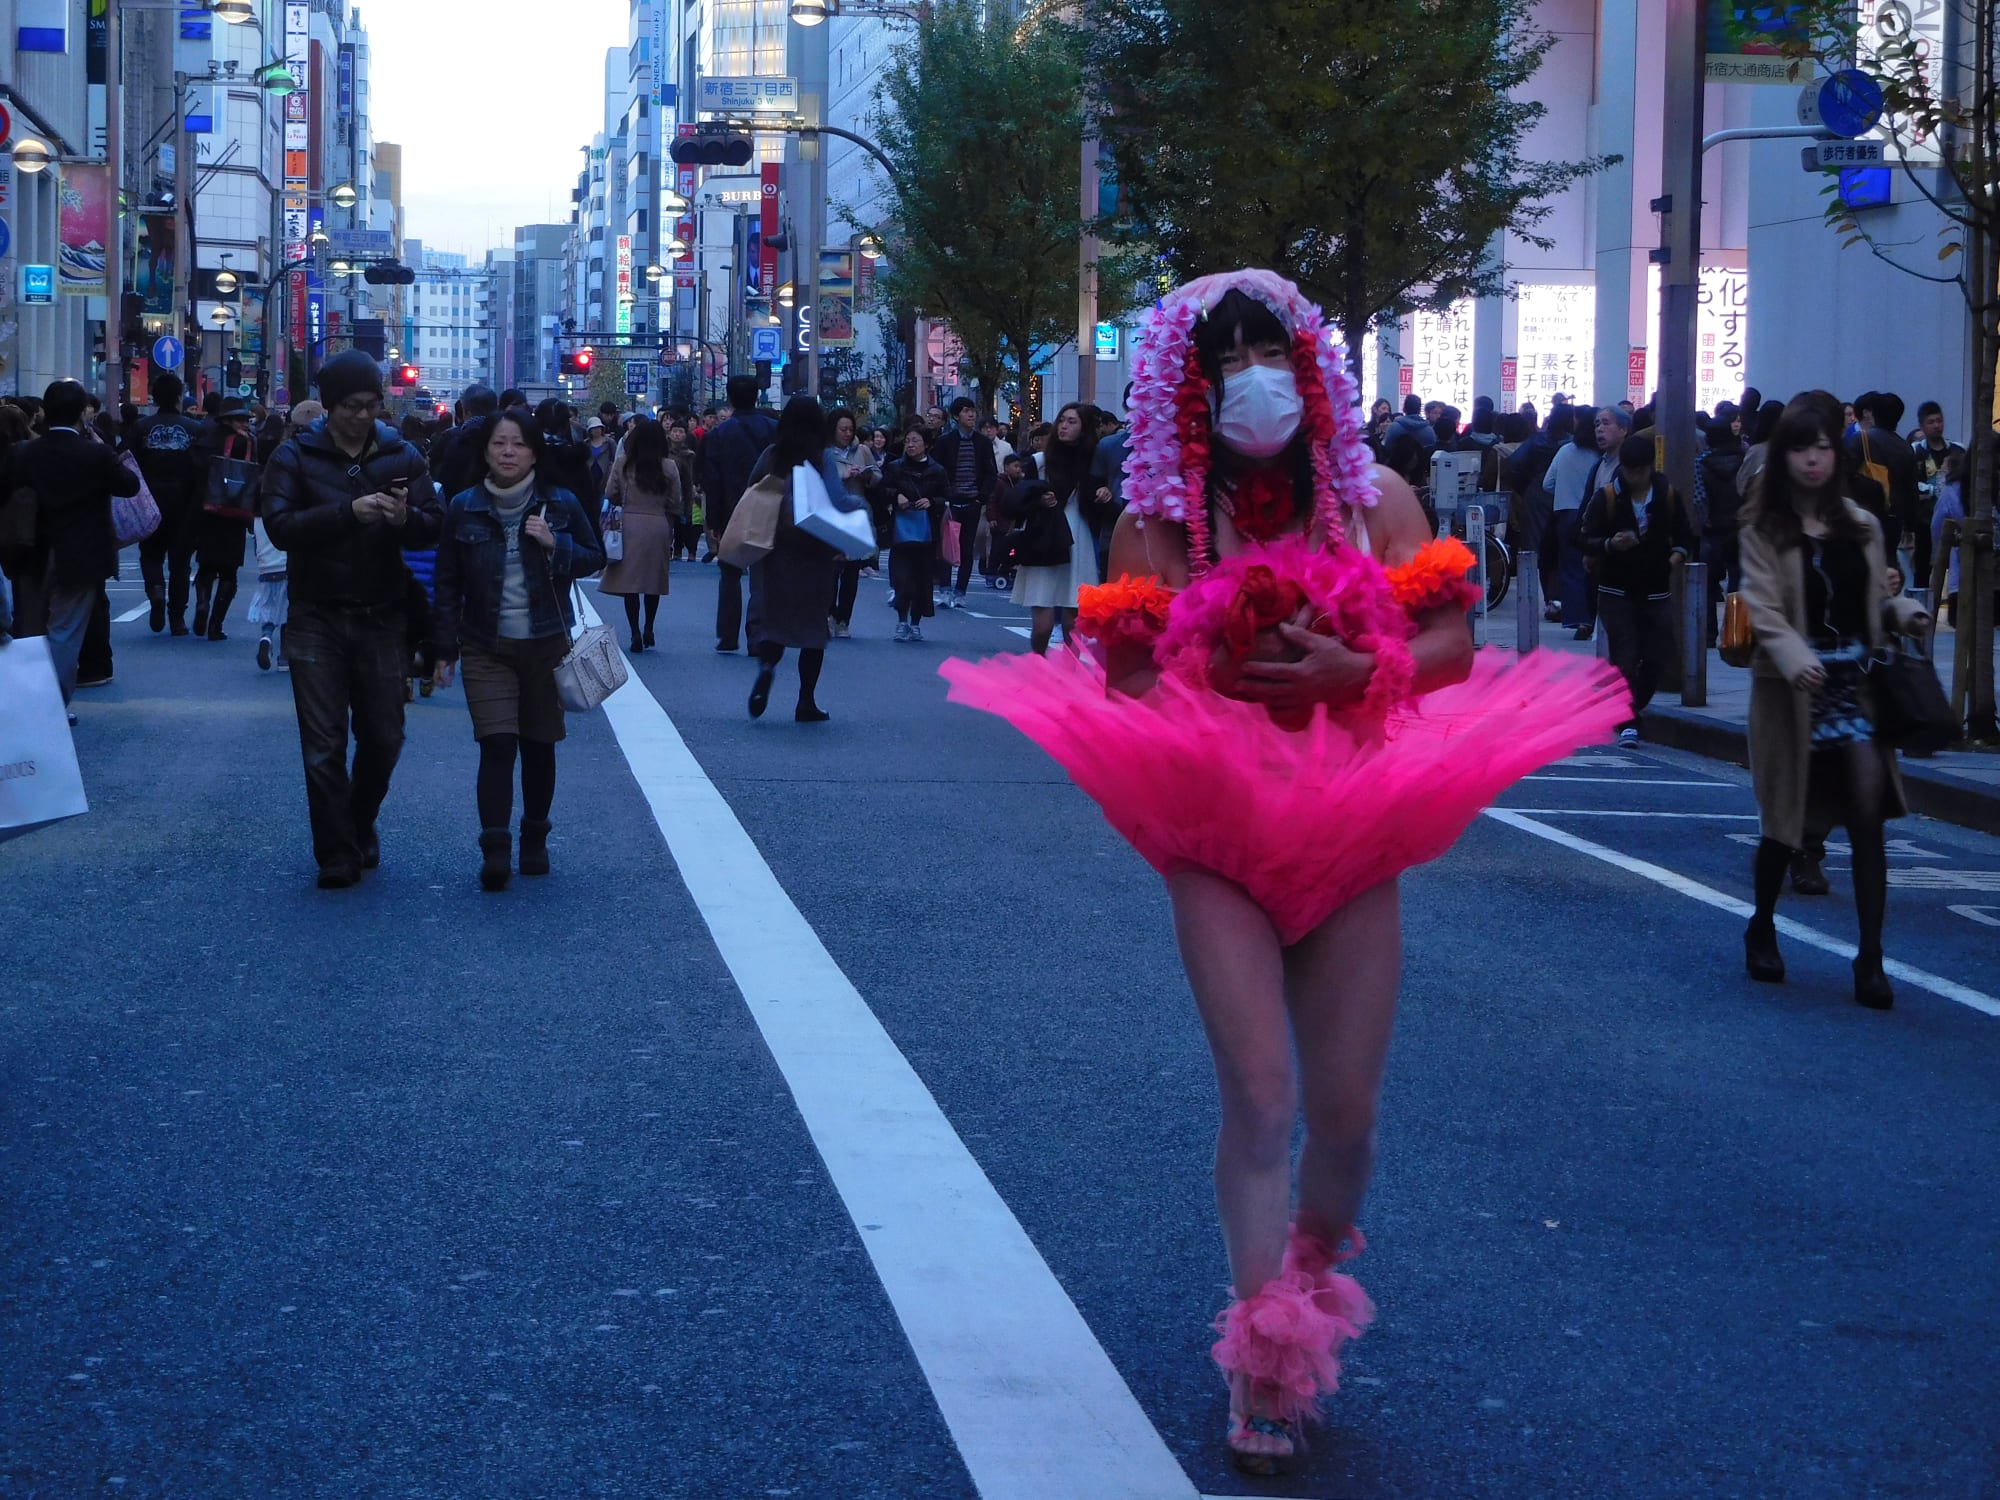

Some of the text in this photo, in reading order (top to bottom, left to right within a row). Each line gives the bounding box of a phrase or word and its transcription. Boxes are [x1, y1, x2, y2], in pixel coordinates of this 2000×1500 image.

[652, 54, 660, 88] CINEMA
[704, 82, 793, 97] 新宿三丁目西
[1823, 146, 1878, 161] 歩行者優先
[1630, 356, 1645, 367] 2F
[1503, 364, 1515, 375] 3F
